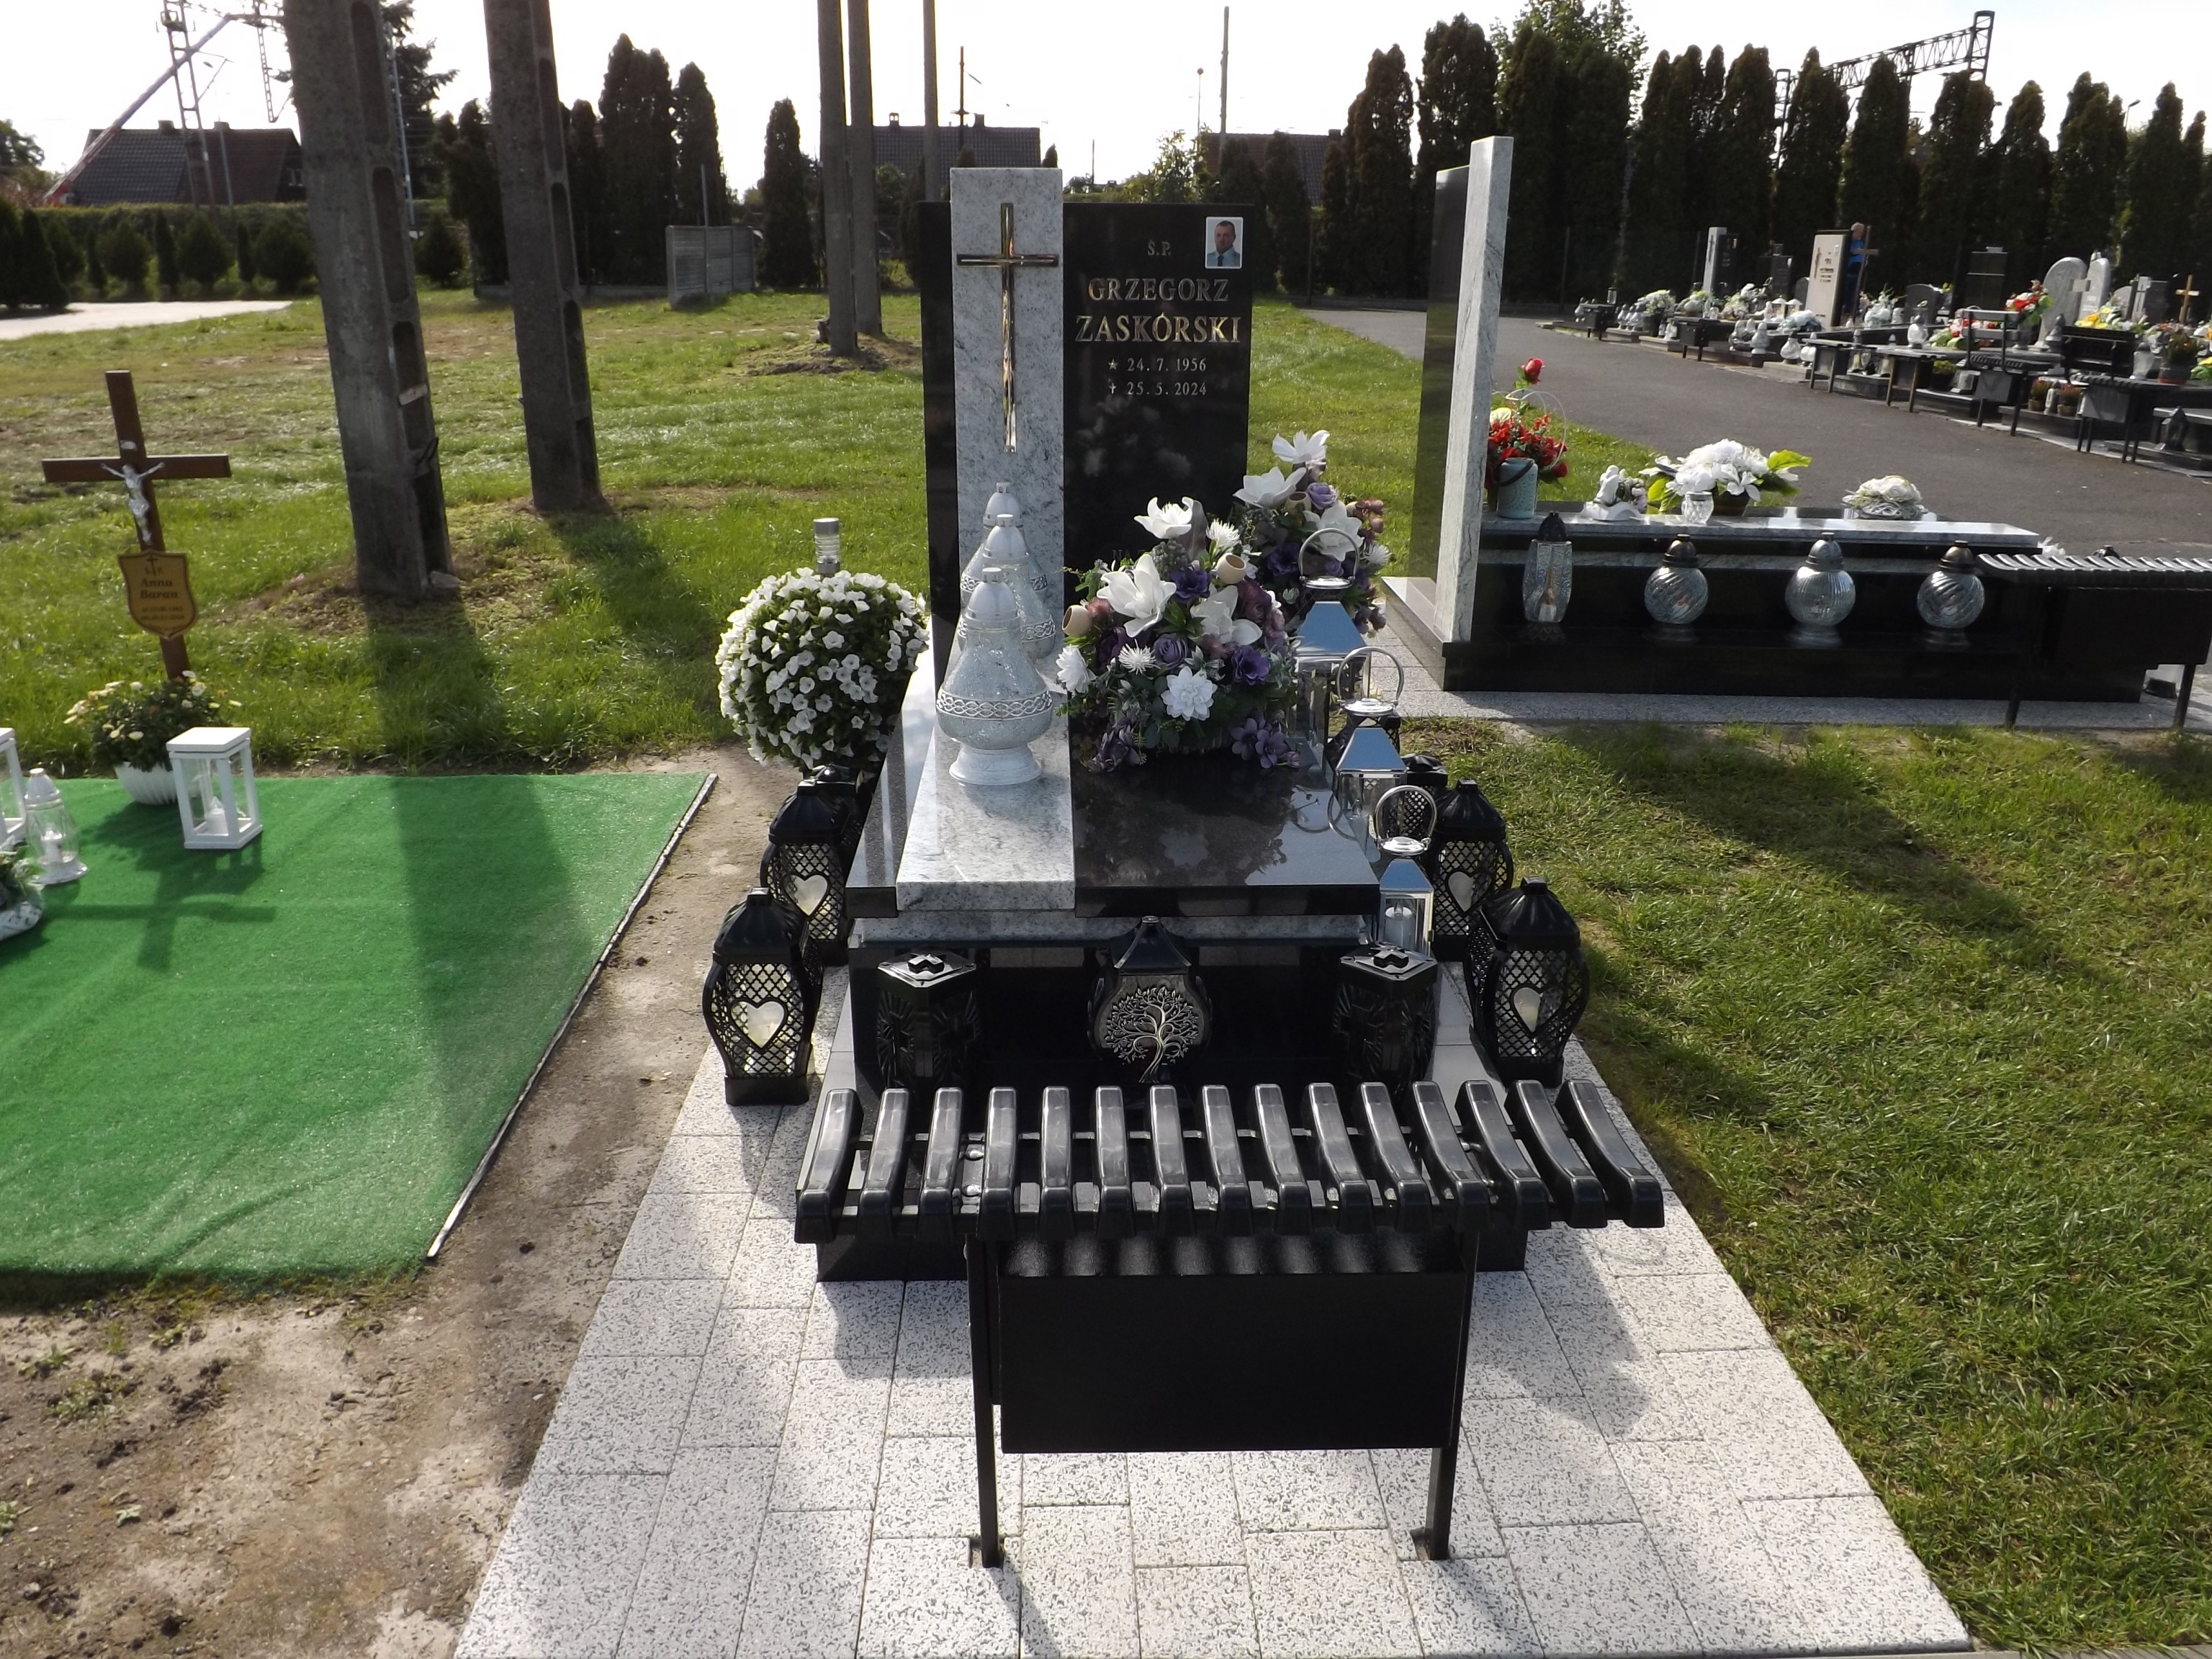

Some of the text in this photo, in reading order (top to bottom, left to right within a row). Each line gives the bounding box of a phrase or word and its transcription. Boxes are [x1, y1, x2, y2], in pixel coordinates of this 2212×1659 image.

[1088, 278, 1228, 301] GRZEGORZ
[1075, 312, 1241, 343] ZASKÓRSKI
[1177, 359, 1207, 372] 1956
[1174, 382, 1207, 395] 2024
